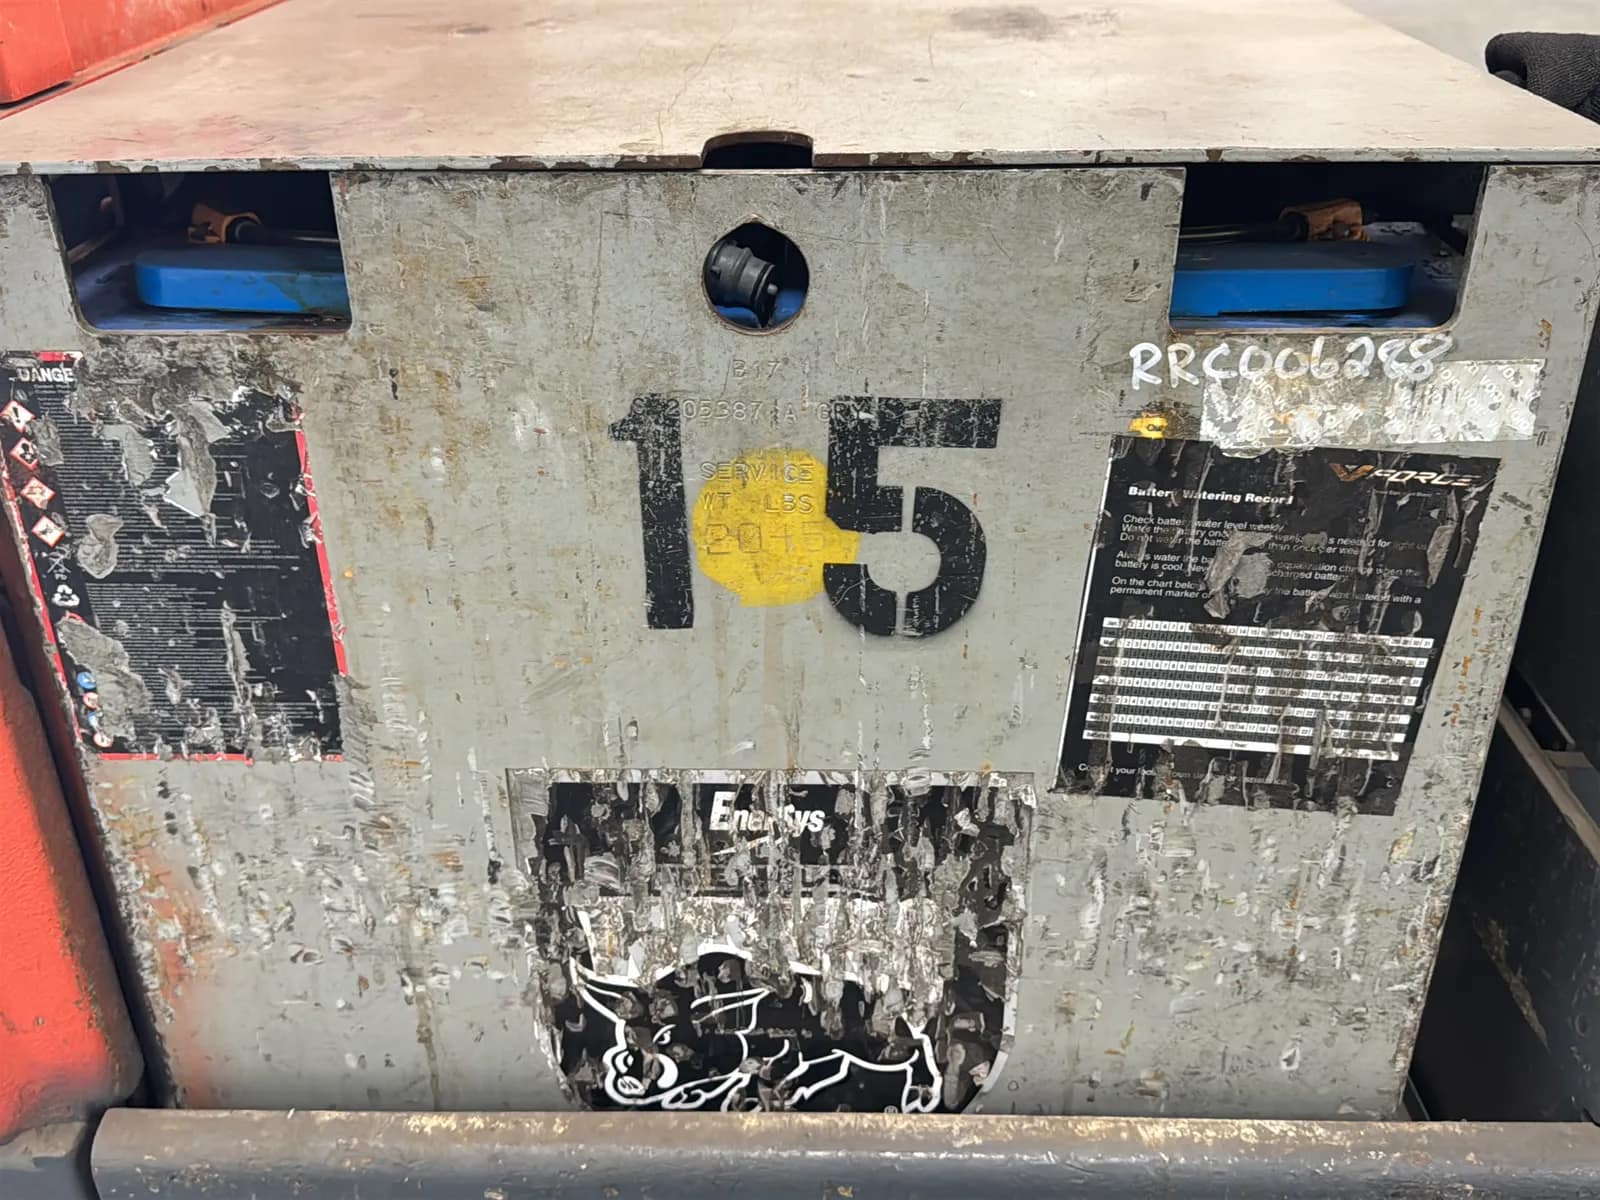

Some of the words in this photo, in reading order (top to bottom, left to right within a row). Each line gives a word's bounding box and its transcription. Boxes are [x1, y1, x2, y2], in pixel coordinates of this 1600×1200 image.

[1130, 334, 1452, 390] RRC006288
[16, 367, 74, 382] DANGE
[701, 462, 814, 483] SERVICE
[764, 493, 814, 513] LBS
[608, 392, 1001, 637] 15
[1123, 514, 1154, 525] Check
[1224, 520, 1247, 530] level
[1120, 532, 1134, 542] Do
[1115, 560, 1148, 571] battery
[1151, 562, 1159, 571] is
[1153, 553, 1181, 562] water
[1110, 587, 1163, 598] permanent
[1165, 589, 1200, 599] marker
[1112, 576, 1127, 585] On
[1130, 577, 1144, 586] the
[1147, 579, 1173, 588] chart
[1393, 594, 1412, 604] with
